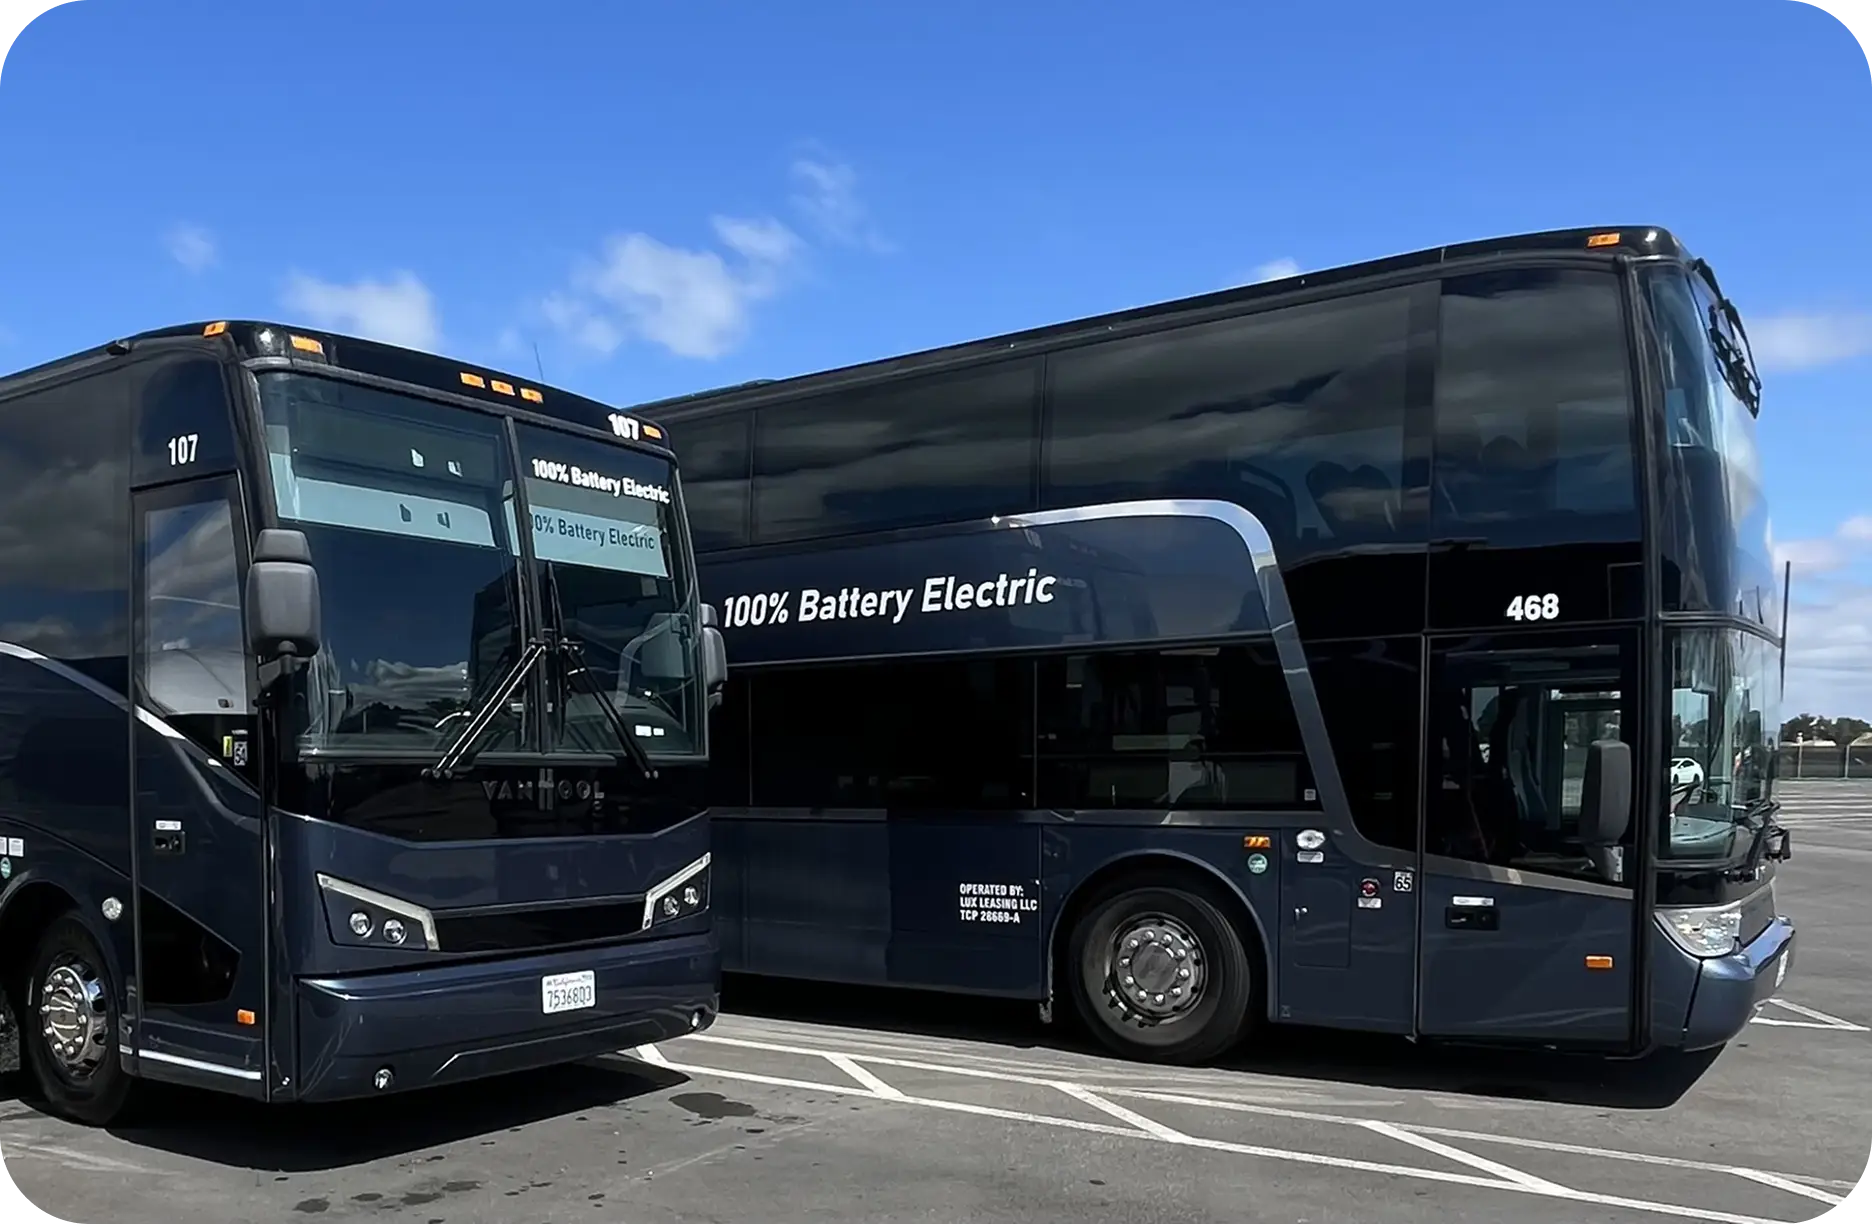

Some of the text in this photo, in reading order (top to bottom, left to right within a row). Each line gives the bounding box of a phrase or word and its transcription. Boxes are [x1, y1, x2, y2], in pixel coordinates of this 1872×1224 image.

[608, 413, 639, 440] 107
[168, 433, 198, 466] 107
[531, 459, 670, 503] 100% Battery Electric
[558, 519, 605, 546] Battery
[609, 528, 655, 549] Electric
[724, 568, 1057, 628] 100% Battery Electric
[1506, 593, 1560, 621] 468
[960, 883, 1024, 897] OPERATED BY:
[1396, 876, 1411, 890] 65
[960, 897, 1037, 911] LUX LEASING LLC
[960, 910, 978, 921] TCP
